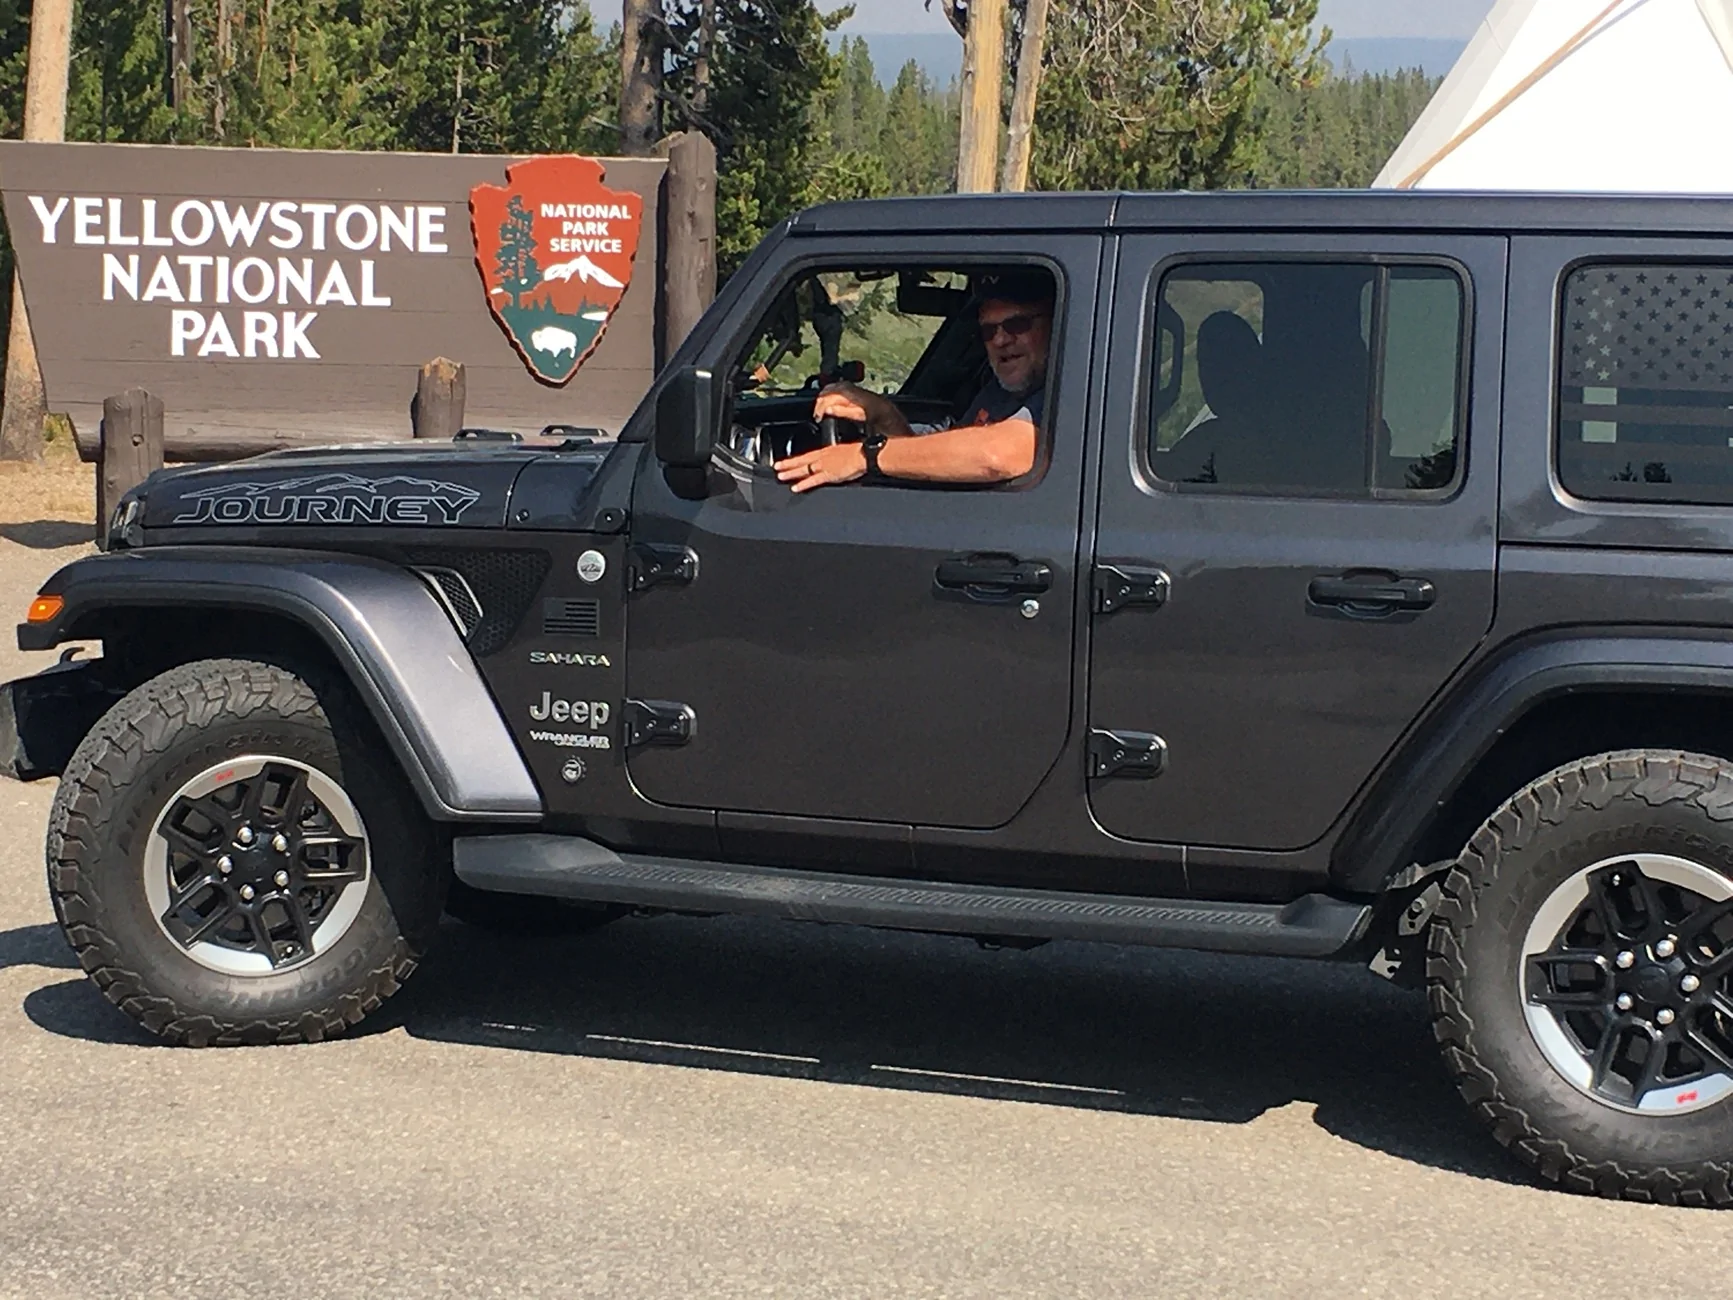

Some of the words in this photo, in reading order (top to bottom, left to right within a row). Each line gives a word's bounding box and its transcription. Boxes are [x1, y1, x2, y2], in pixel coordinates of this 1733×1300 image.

[541, 203, 632, 220] NATIONAL
[28, 196, 448, 253] YELLOWSTONE
[562, 221, 609, 237] PARK
[549, 237, 622, 254] SERVICE
[102, 254, 392, 306] NATIONAL
[171, 310, 321, 359] PARK
[173, 495, 479, 523] JOURNEY
[529, 651, 611, 667] SAHARA
[529, 691, 610, 730] Jeep
[529, 729, 610, 747] WRANGLER
